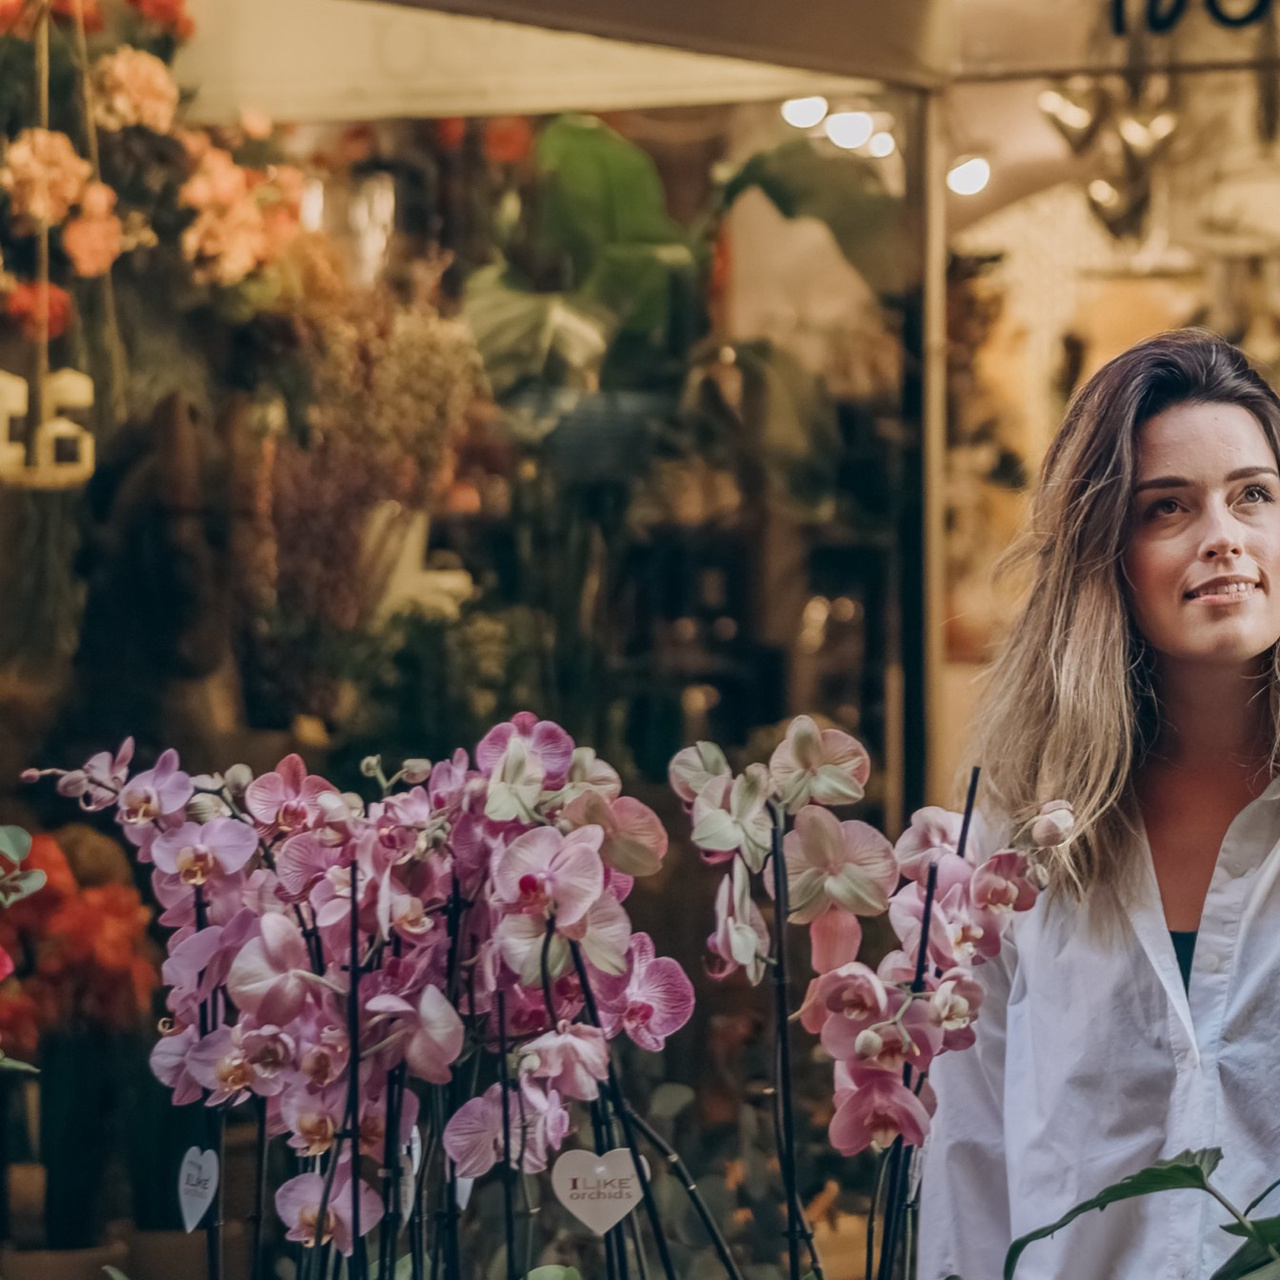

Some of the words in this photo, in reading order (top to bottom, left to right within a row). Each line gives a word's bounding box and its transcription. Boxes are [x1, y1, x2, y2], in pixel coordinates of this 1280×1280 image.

[569, 1177, 579, 1190] I
[582, 1177, 632, 1190] LIKE
[569, 1190, 633, 1200] orchids
